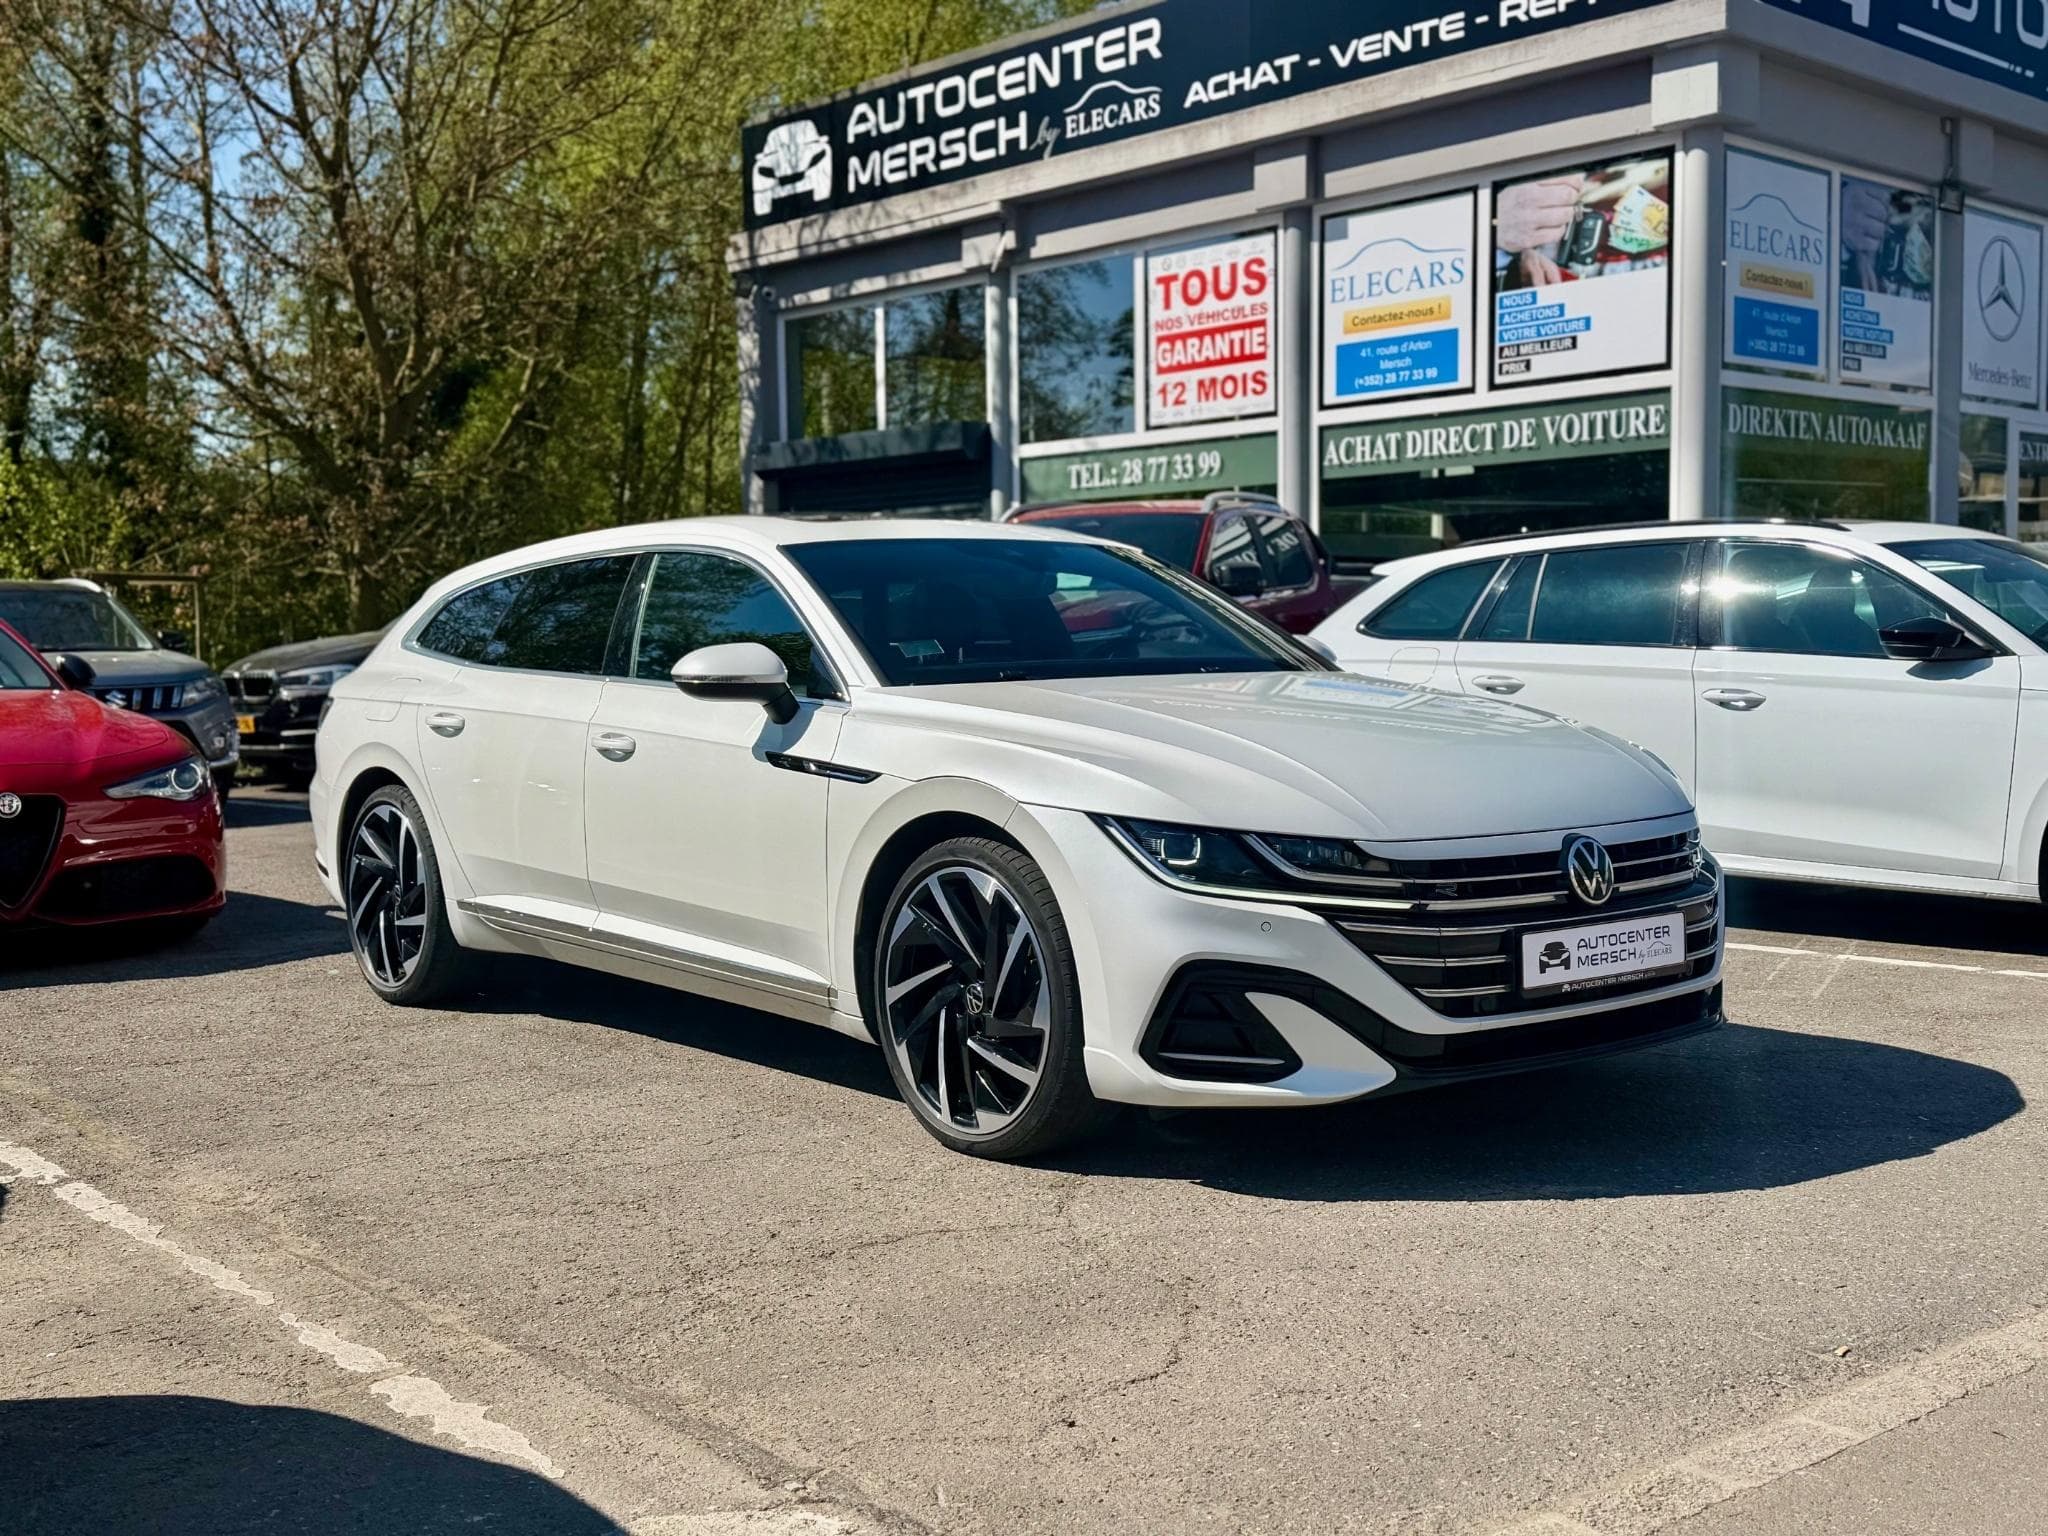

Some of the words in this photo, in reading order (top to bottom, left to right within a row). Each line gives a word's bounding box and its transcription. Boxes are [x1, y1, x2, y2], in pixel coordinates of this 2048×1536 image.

[1183, 54, 1300, 108] ACHAT
[1329, 12, 1466, 68] VENTE
[847, 18, 1163, 144] AUTOCENTER
[847, 111, 1028, 193] MERSCH
[1030, 116, 1061, 160] by
[1065, 94, 1161, 139] ELECARS
[1730, 220, 1823, 265] ELECARS
[1156, 257, 1267, 311] TOUS
[1330, 257, 1464, 304] ELECARS
[1352, 306, 1436, 328] Contactez-nous
[1502, 293, 1533, 307] NOUS
[1502, 306, 1561, 325] ACHETONS
[1155, 317, 1183, 332] NOS
[1502, 326, 1537, 342] VOTRE
[1538, 319, 1586, 336] VOITURE
[1156, 326, 1266, 369] GARANTIE
[1502, 345, 1517, 359] AU
[1502, 361, 1527, 375] PRIX
[1158, 382, 1187, 408] 12
[1197, 370, 1268, 403] MOIS
[1324, 432, 1401, 466] ACHAT
[1406, 422, 1497, 459] DIRECT
[1503, 418, 1536, 449] DE
[1543, 404, 1666, 444] VOITURE
[1728, 403, 1822, 441] DIREKTEN
[1824, 413, 1926, 450] AUTOAKAAF
[1067, 462, 1117, 490] TEL.:
[1121, 458, 1144, 485] 28
[1147, 455, 1168, 482] 77
[1172, 453, 1194, 480] 33
[1198, 450, 1221, 478] 99
[1577, 925, 1671, 951] AUTOCENTER
[1577, 947, 1636, 969] MERSCH
[1572, 977, 1617, 991] AUTOCENTER
[1618, 973, 1644, 984] MERSCH
